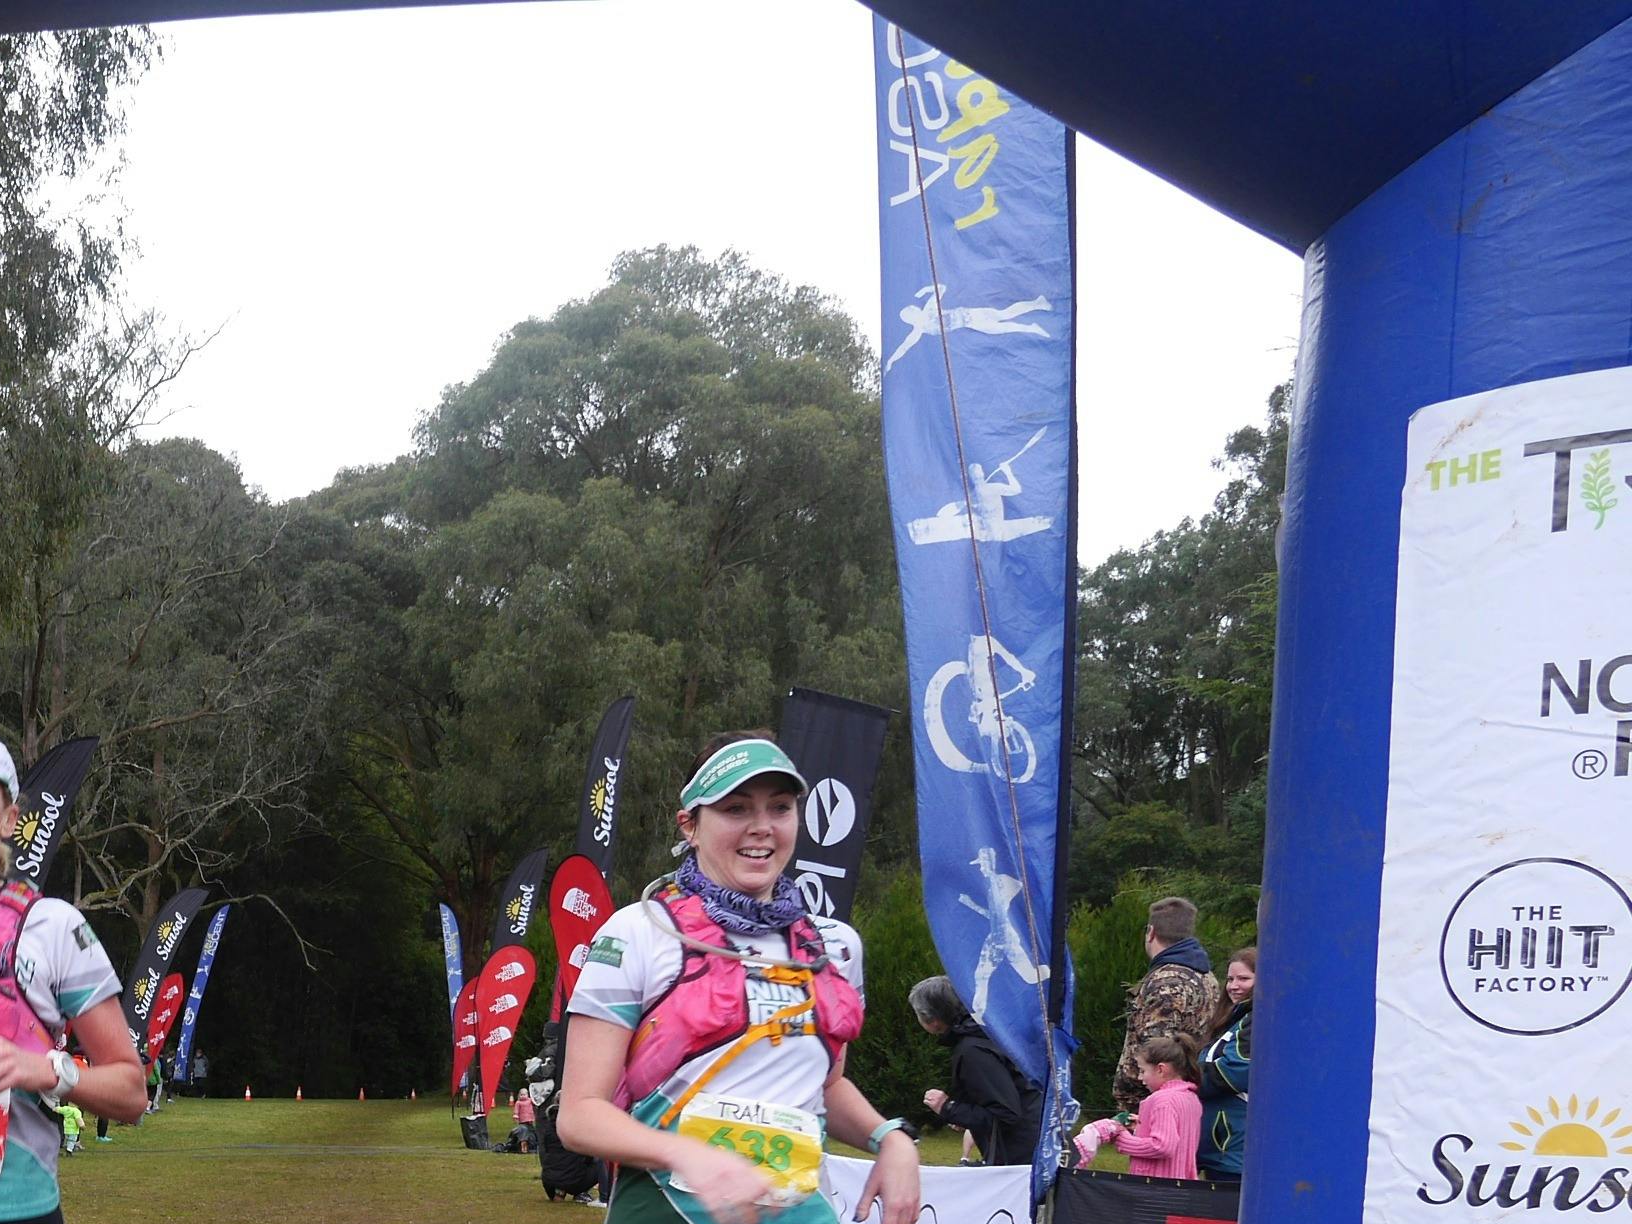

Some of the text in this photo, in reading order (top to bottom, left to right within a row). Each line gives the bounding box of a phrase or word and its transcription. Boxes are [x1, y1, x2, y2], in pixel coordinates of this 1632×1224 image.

[1425, 448, 1502, 491] THE
[594, 756, 621, 847] Sunsol
[15, 791, 65, 878] Sunsol
[510, 883, 535, 937] Sunsol
[1512, 905, 1563, 922] THE
[156, 911, 188, 961] Sunsol
[1467, 924, 1616, 971] HIIT
[134, 967, 160, 1020] Sunsol
[718, 1101, 771, 1125] TRAIL
[1416, 1133, 1632, 1213] Suns
